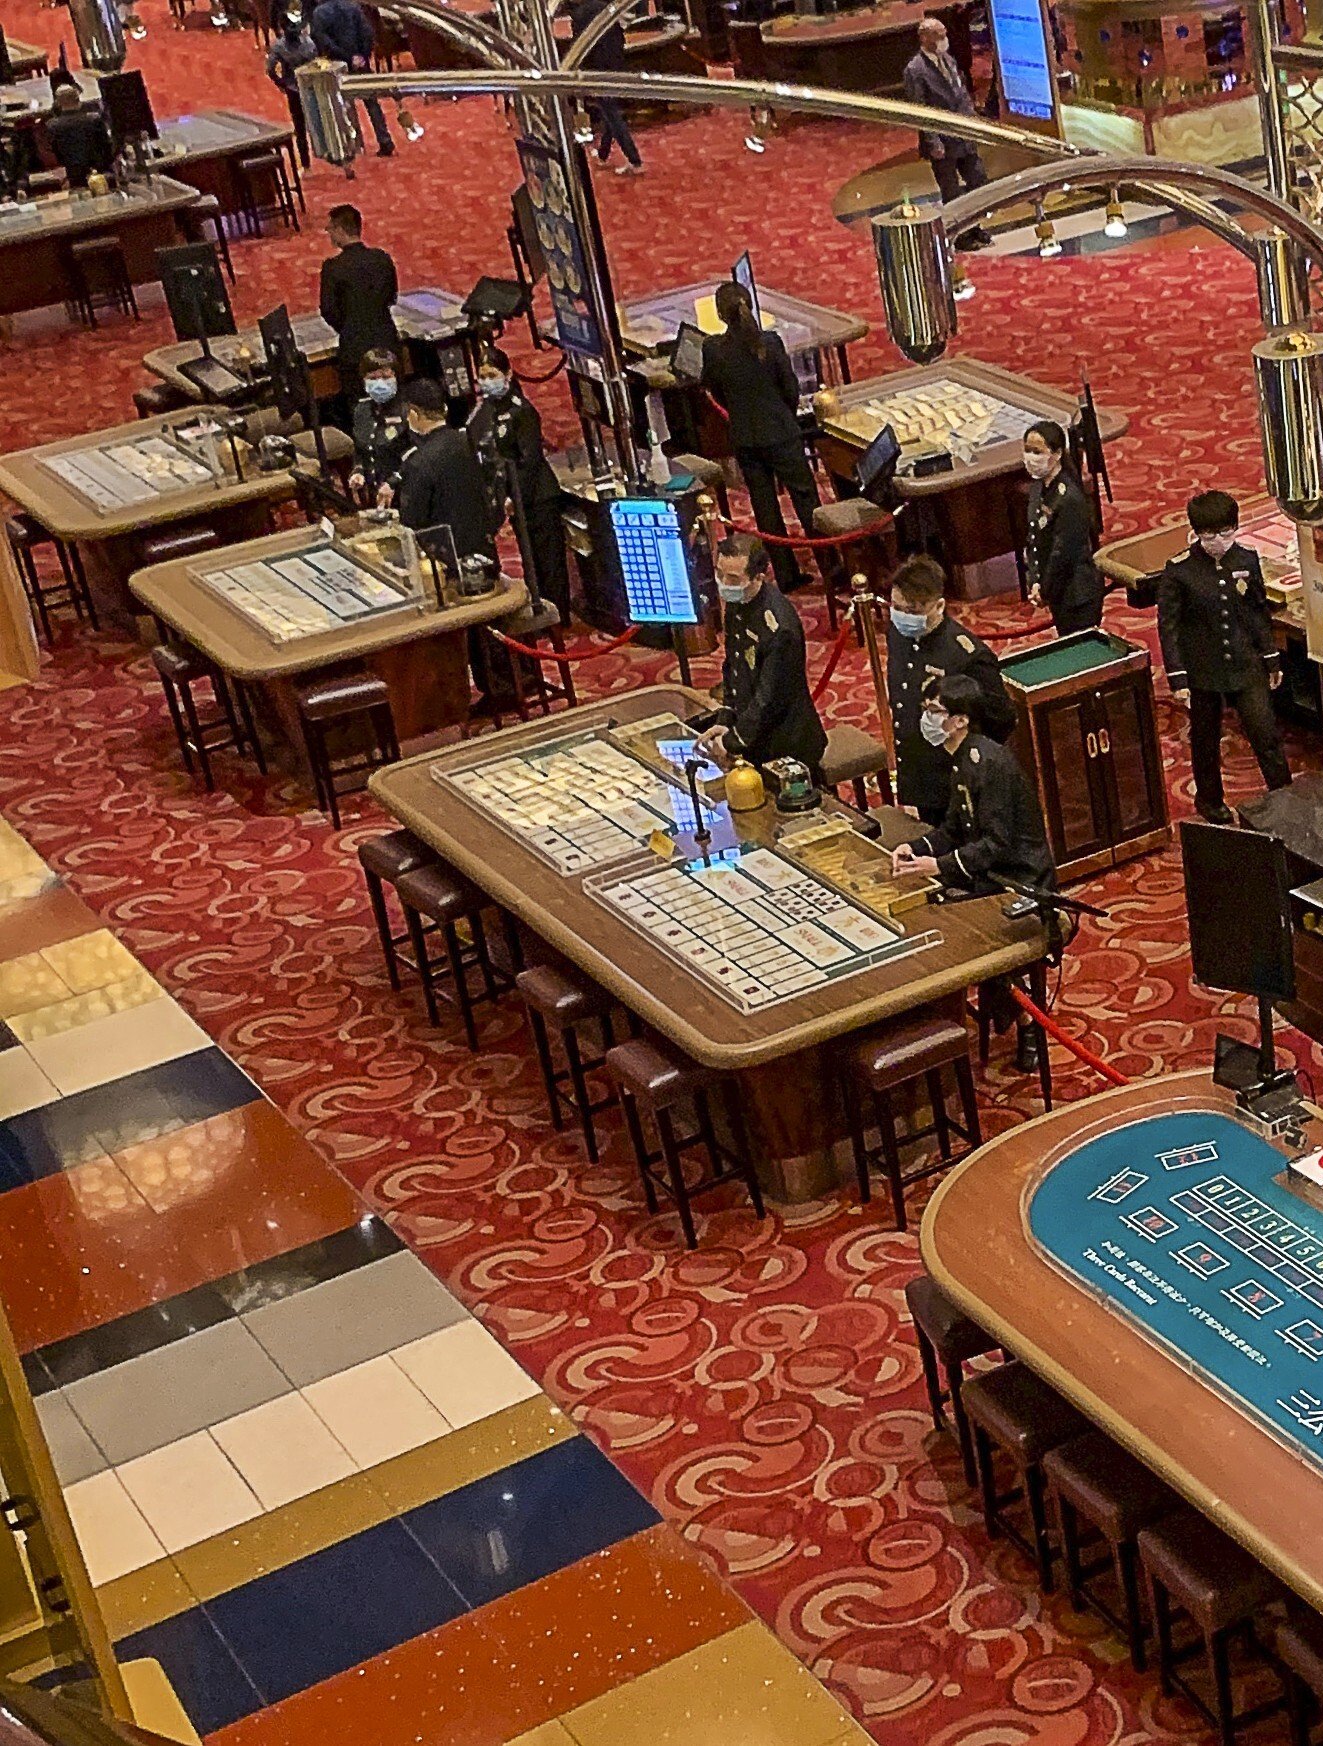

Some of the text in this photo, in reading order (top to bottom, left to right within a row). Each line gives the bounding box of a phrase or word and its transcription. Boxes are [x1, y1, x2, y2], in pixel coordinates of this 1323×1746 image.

[1207, 1184, 1225, 1194] 0
[1223, 1196, 1241, 1206] 1
[1240, 1208, 1259, 1219] 2
[1259, 1220, 1278, 1231] 3
[1278, 1233, 1297, 1244] 4
[1296, 1245, 1316, 1256] 5
[1082, 1248, 1106, 1268] Three
[1103, 1264, 1128, 1283] Cards
